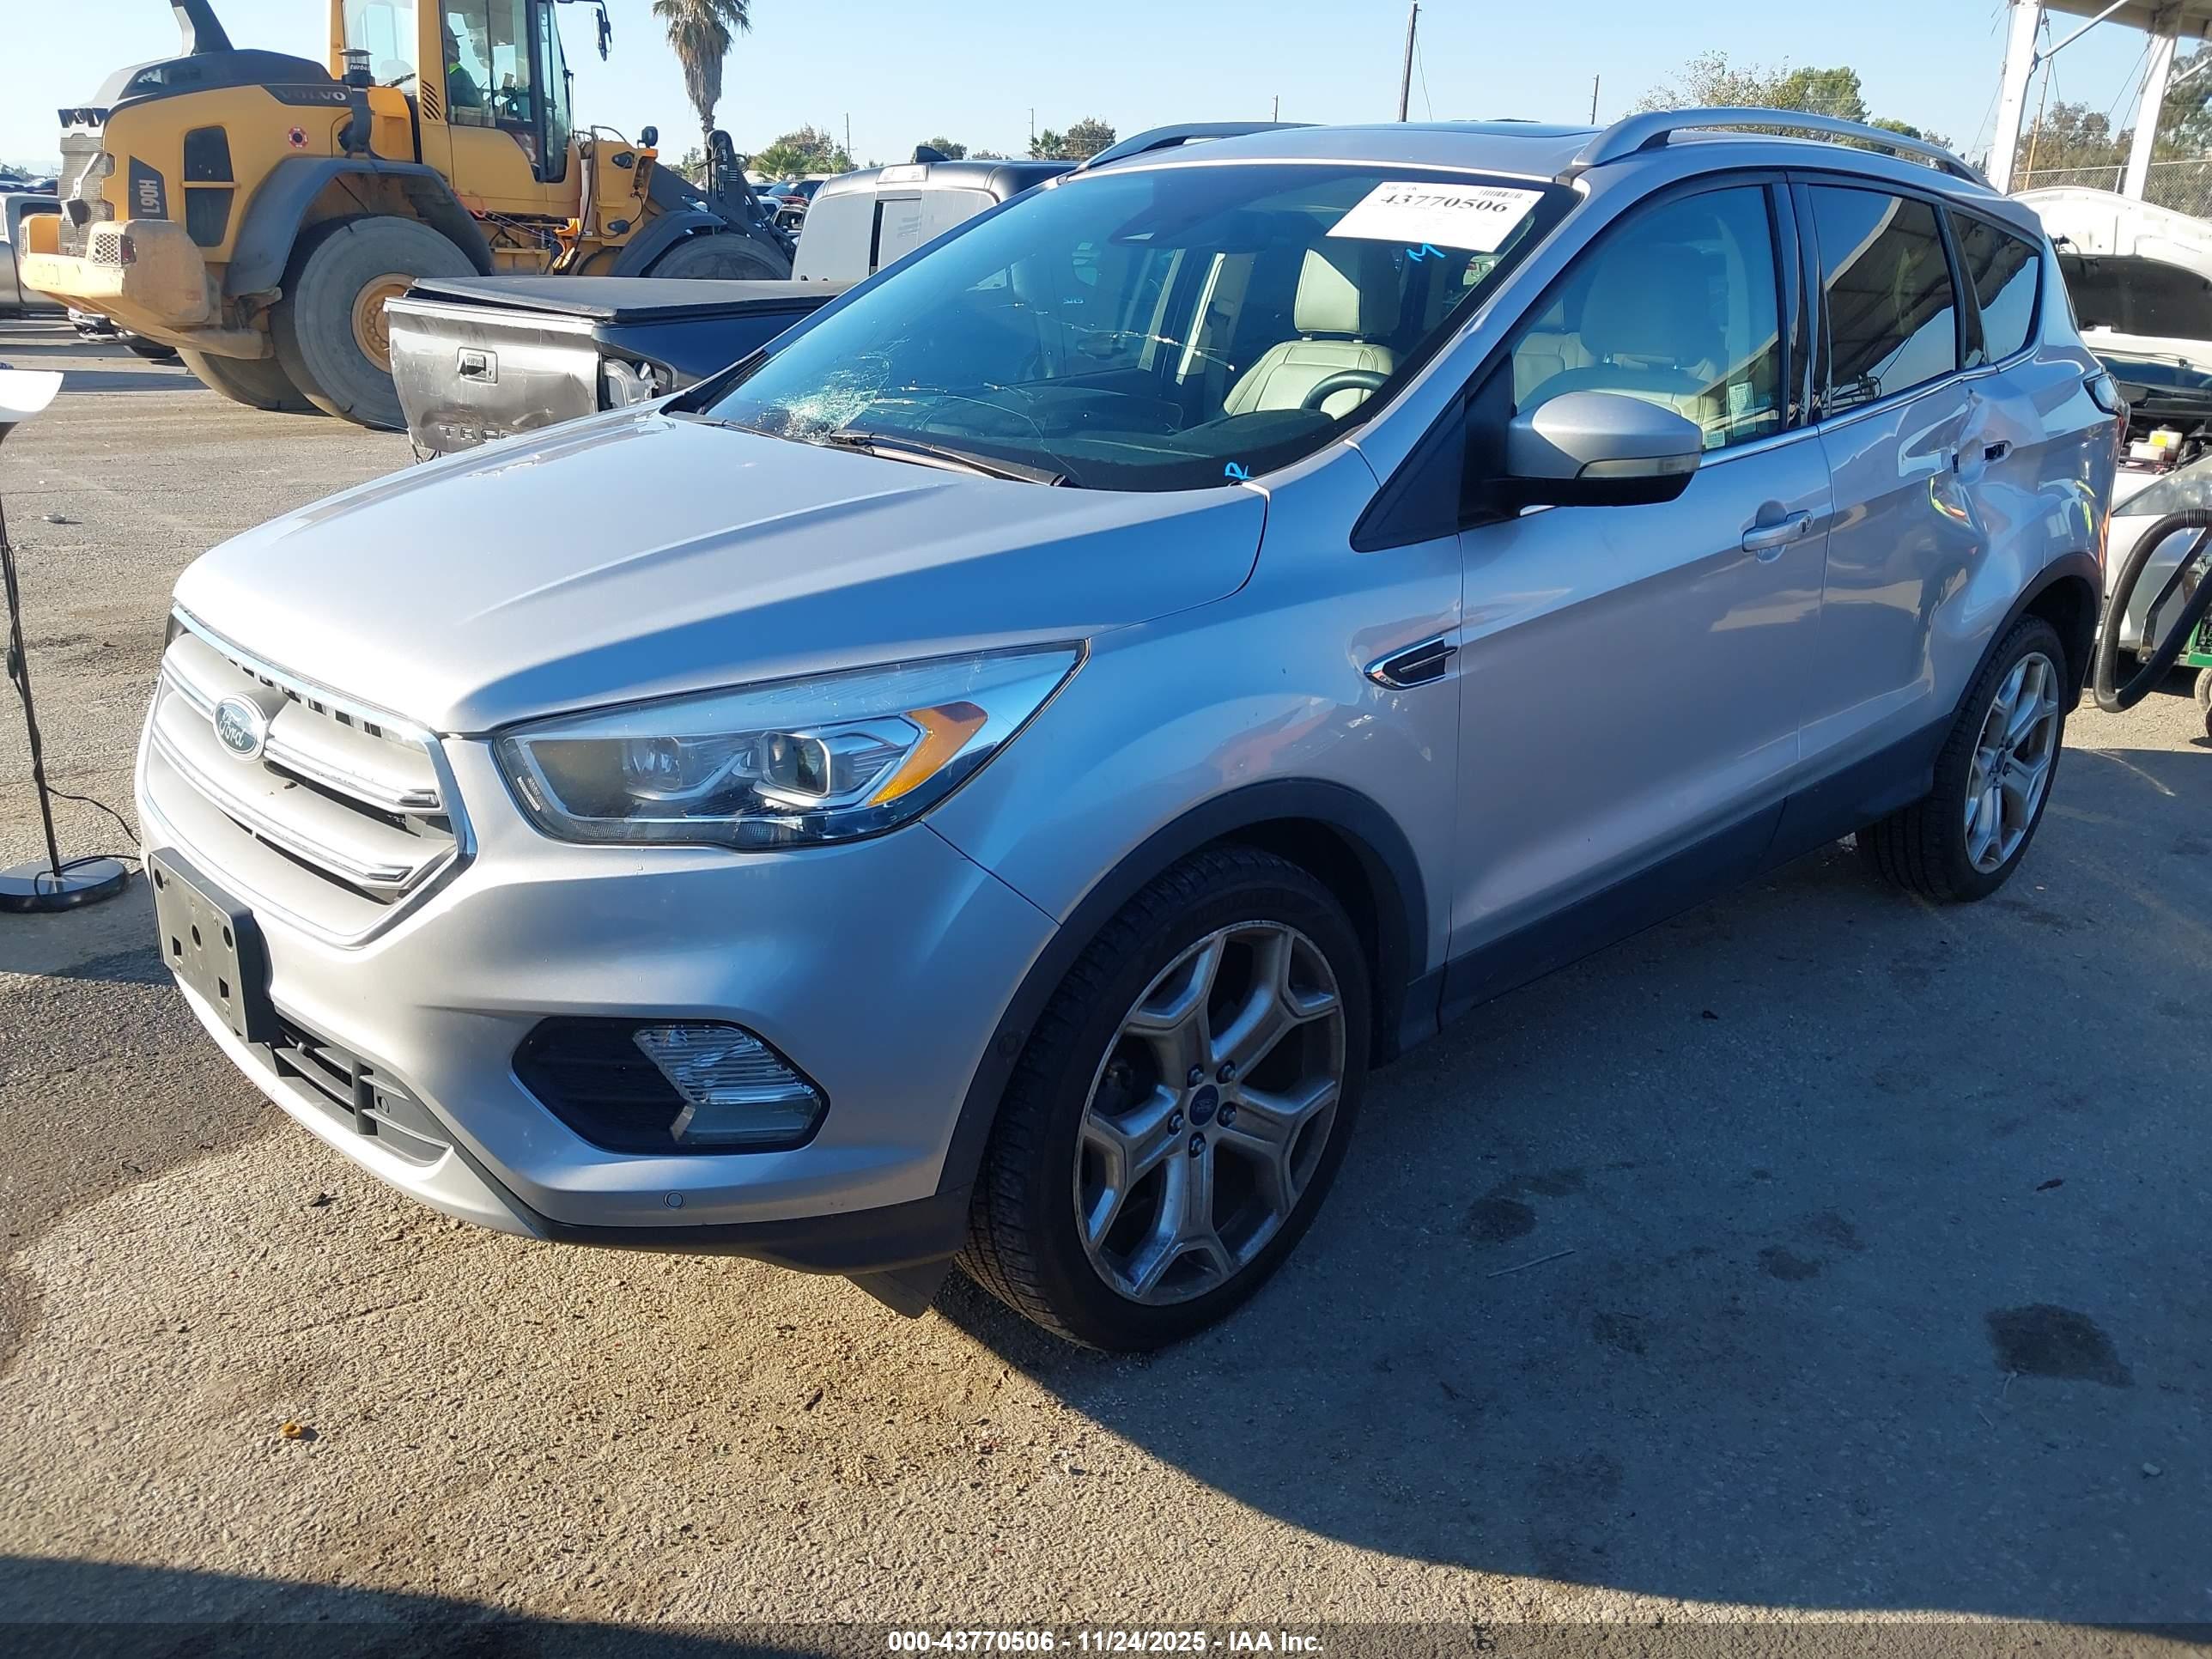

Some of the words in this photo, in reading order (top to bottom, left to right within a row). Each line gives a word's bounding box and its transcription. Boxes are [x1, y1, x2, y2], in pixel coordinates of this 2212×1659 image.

[138, 179, 161, 214] L90H
[1380, 193, 1511, 213] 43770506
[219, 709, 246, 747] Ford
